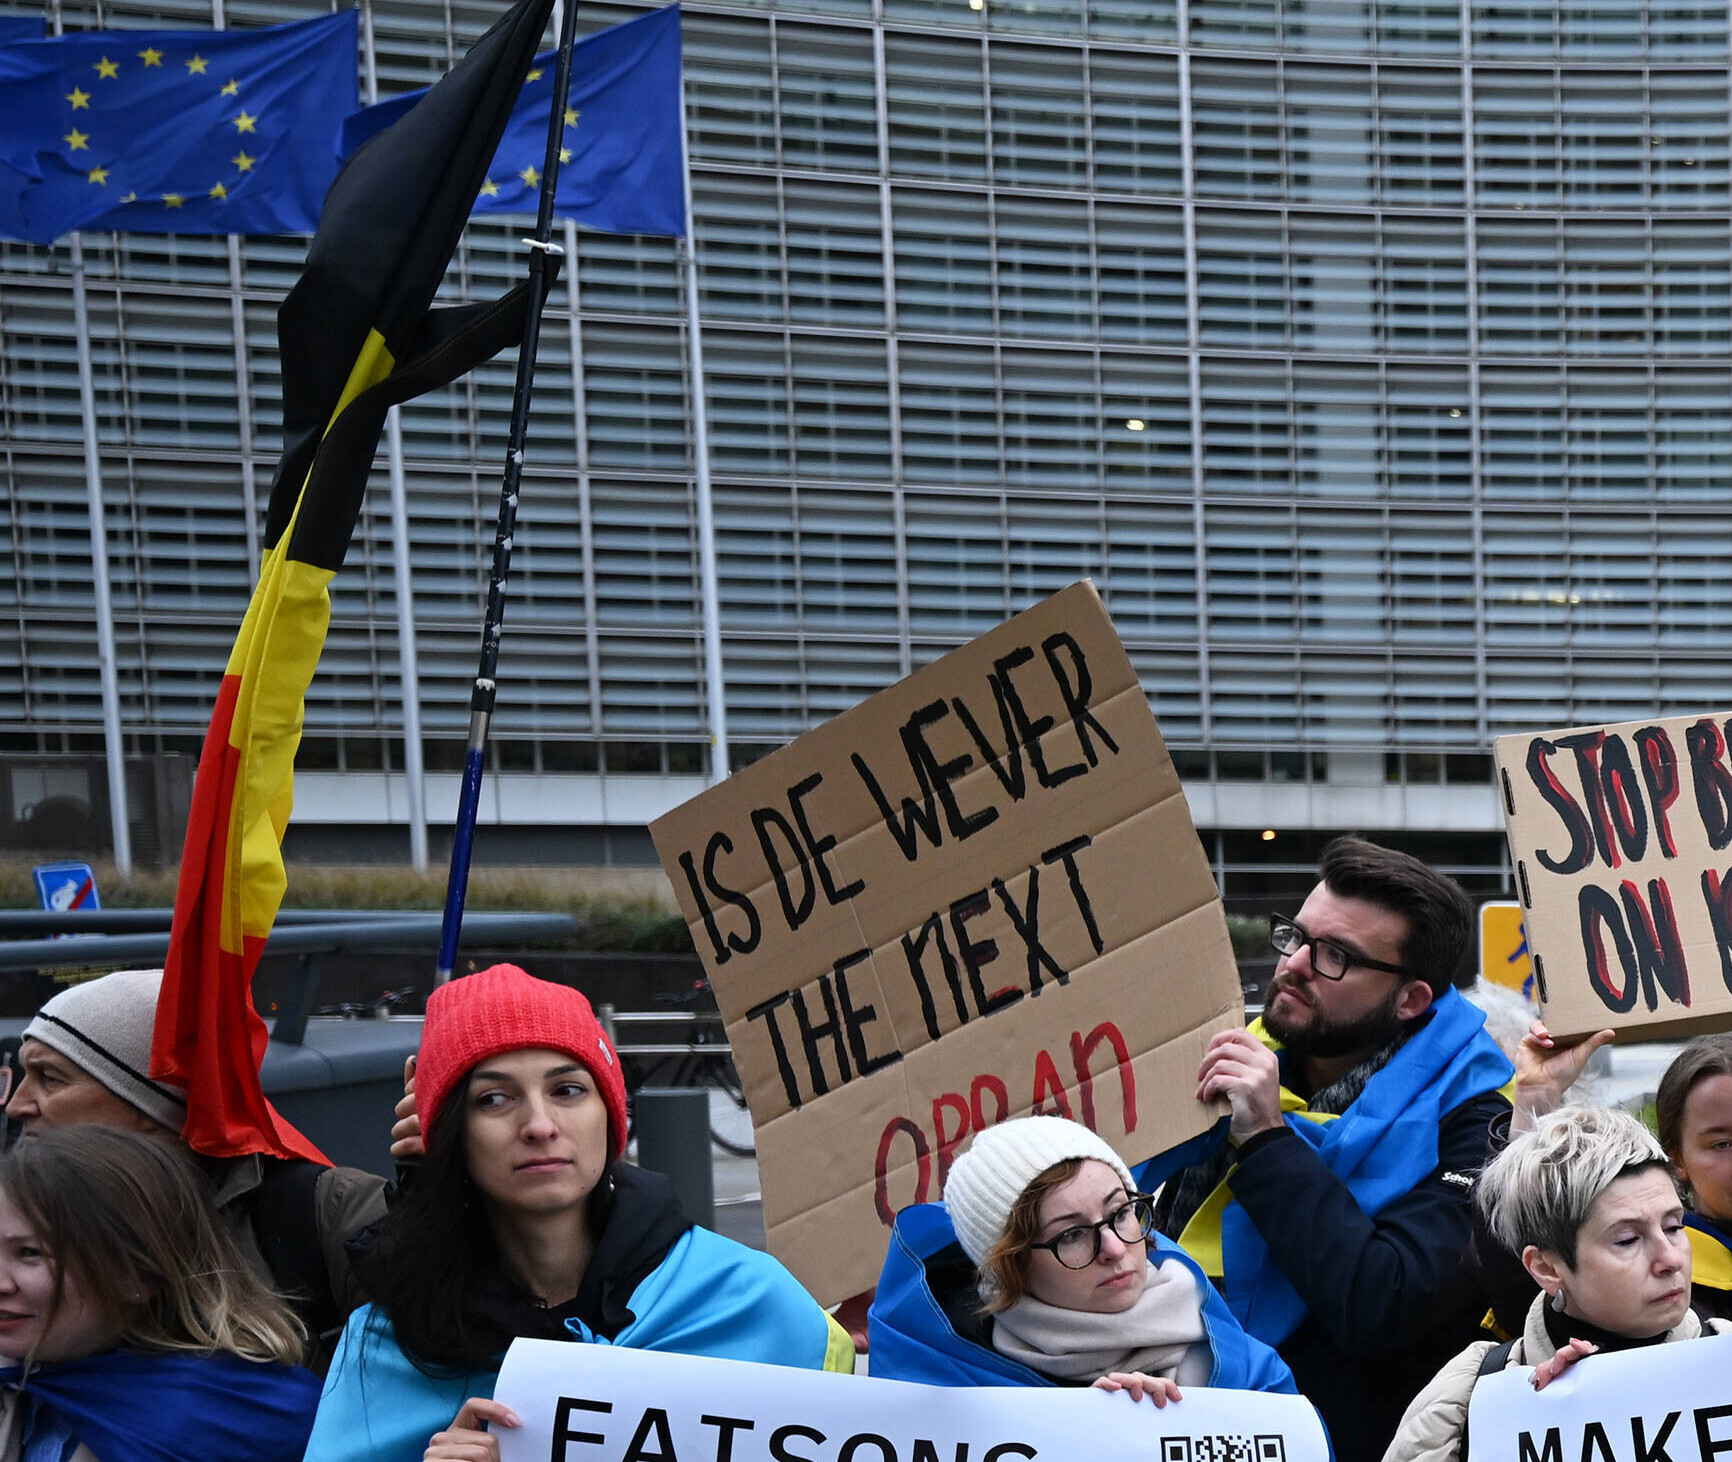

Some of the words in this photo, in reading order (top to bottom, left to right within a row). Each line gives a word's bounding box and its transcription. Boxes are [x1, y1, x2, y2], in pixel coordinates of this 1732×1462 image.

[679, 832, 761, 964] IS
[751, 773, 865, 931] DE
[851, 632, 1119, 861] WEVER
[1526, 726, 1680, 875] STOP
[1578, 876, 1691, 1013] ON
[745, 948, 903, 1110] THE
